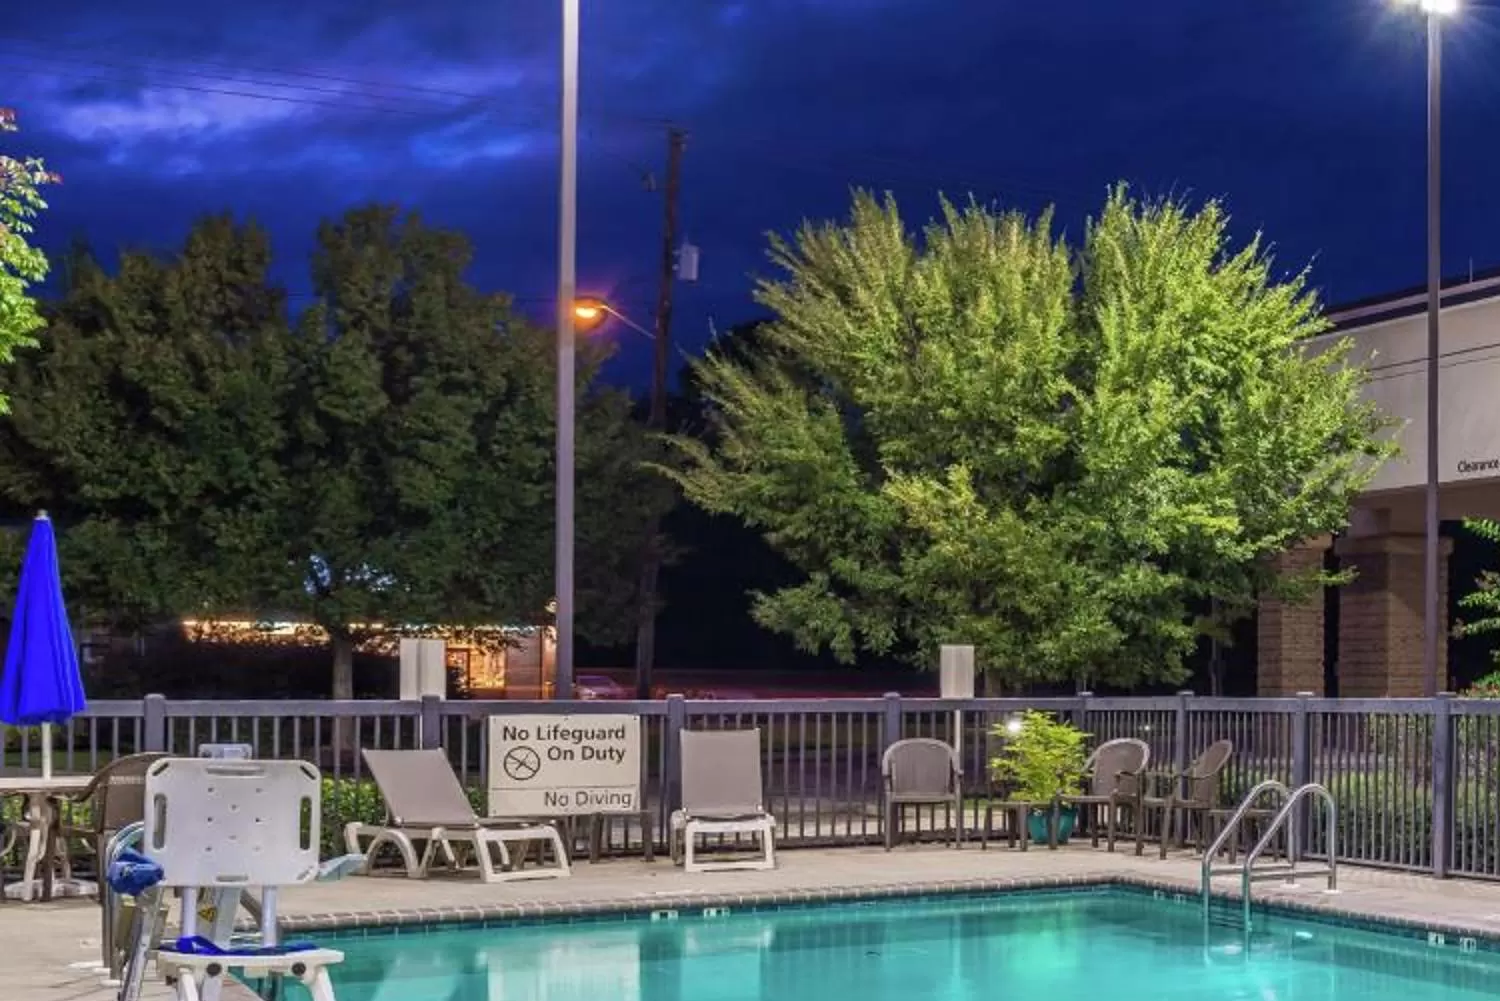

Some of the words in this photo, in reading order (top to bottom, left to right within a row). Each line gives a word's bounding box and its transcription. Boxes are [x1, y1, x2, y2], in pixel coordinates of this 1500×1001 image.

[1457, 459, 1499, 473] Clearance
[502, 725, 529, 741] No
[536, 724, 625, 744] Lifeguard
[547, 746, 575, 761] On
[581, 745, 625, 764] Duty
[544, 791, 569, 807] No
[575, 789, 632, 808] Diving
